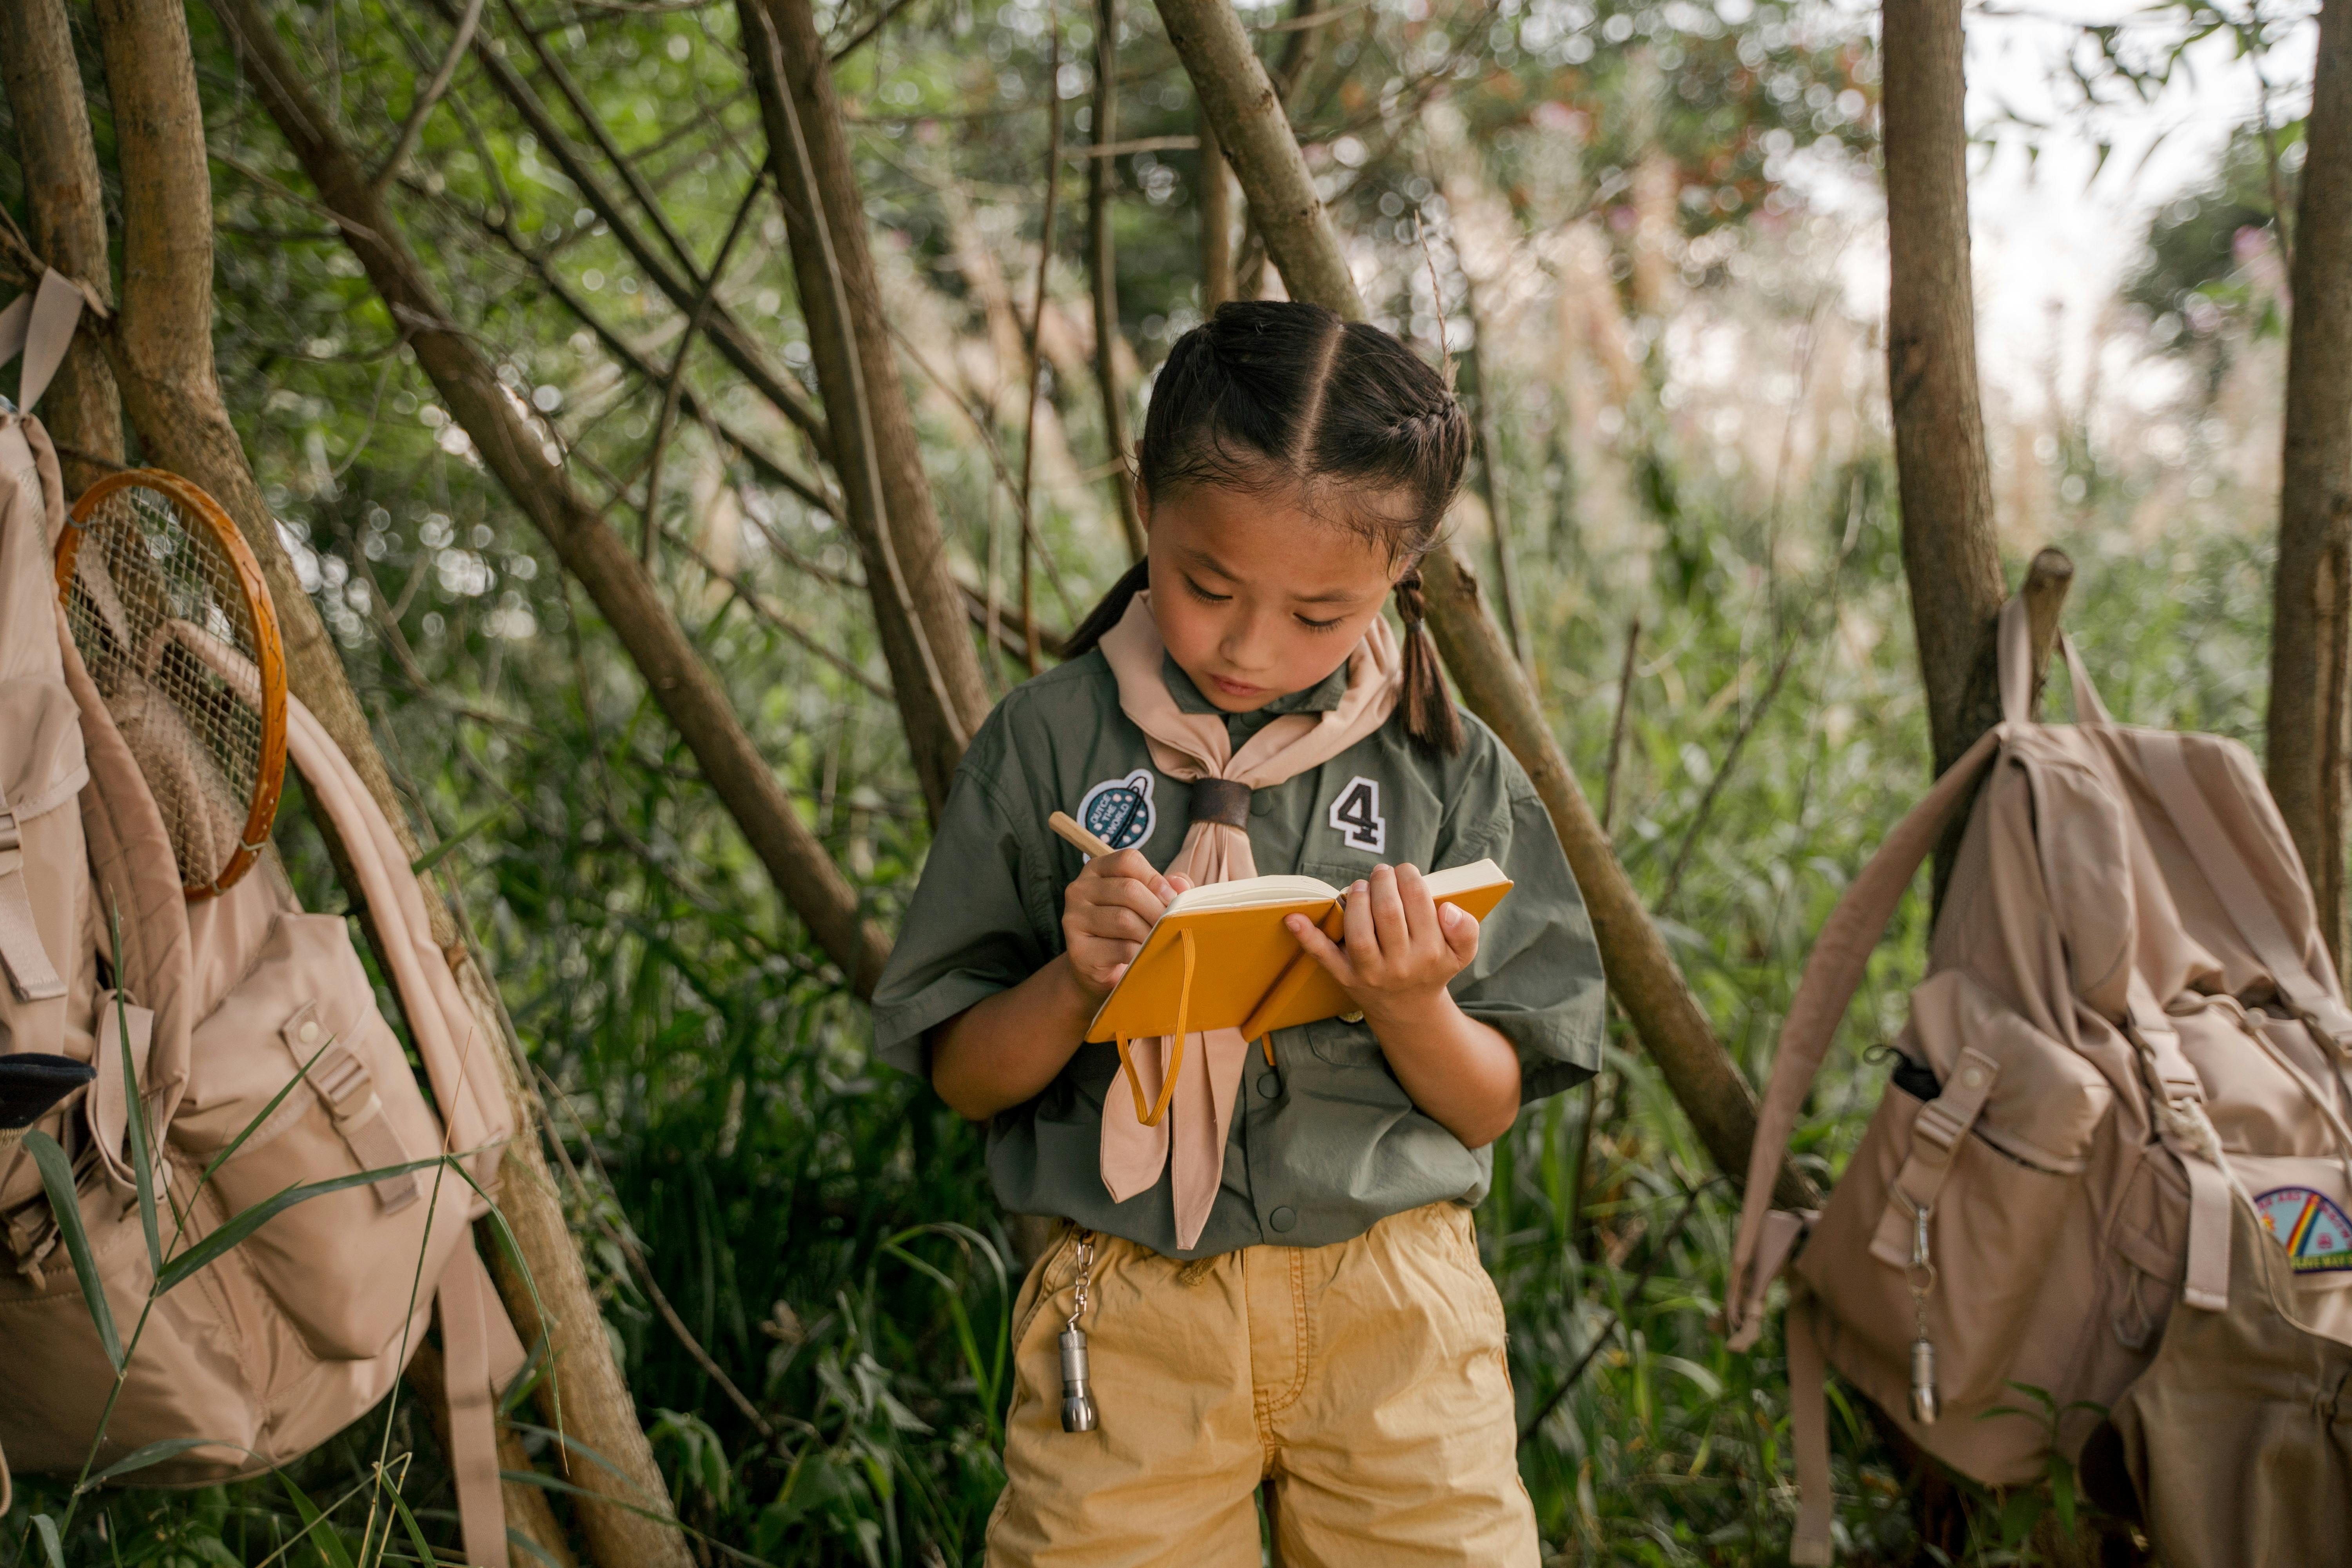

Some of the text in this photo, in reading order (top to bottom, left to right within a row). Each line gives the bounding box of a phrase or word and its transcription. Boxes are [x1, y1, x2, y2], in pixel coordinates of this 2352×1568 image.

[1101, 804, 1117, 822] THE
[1105, 803, 1130, 835] WORLD
[1336, 782, 1379, 847] 4
